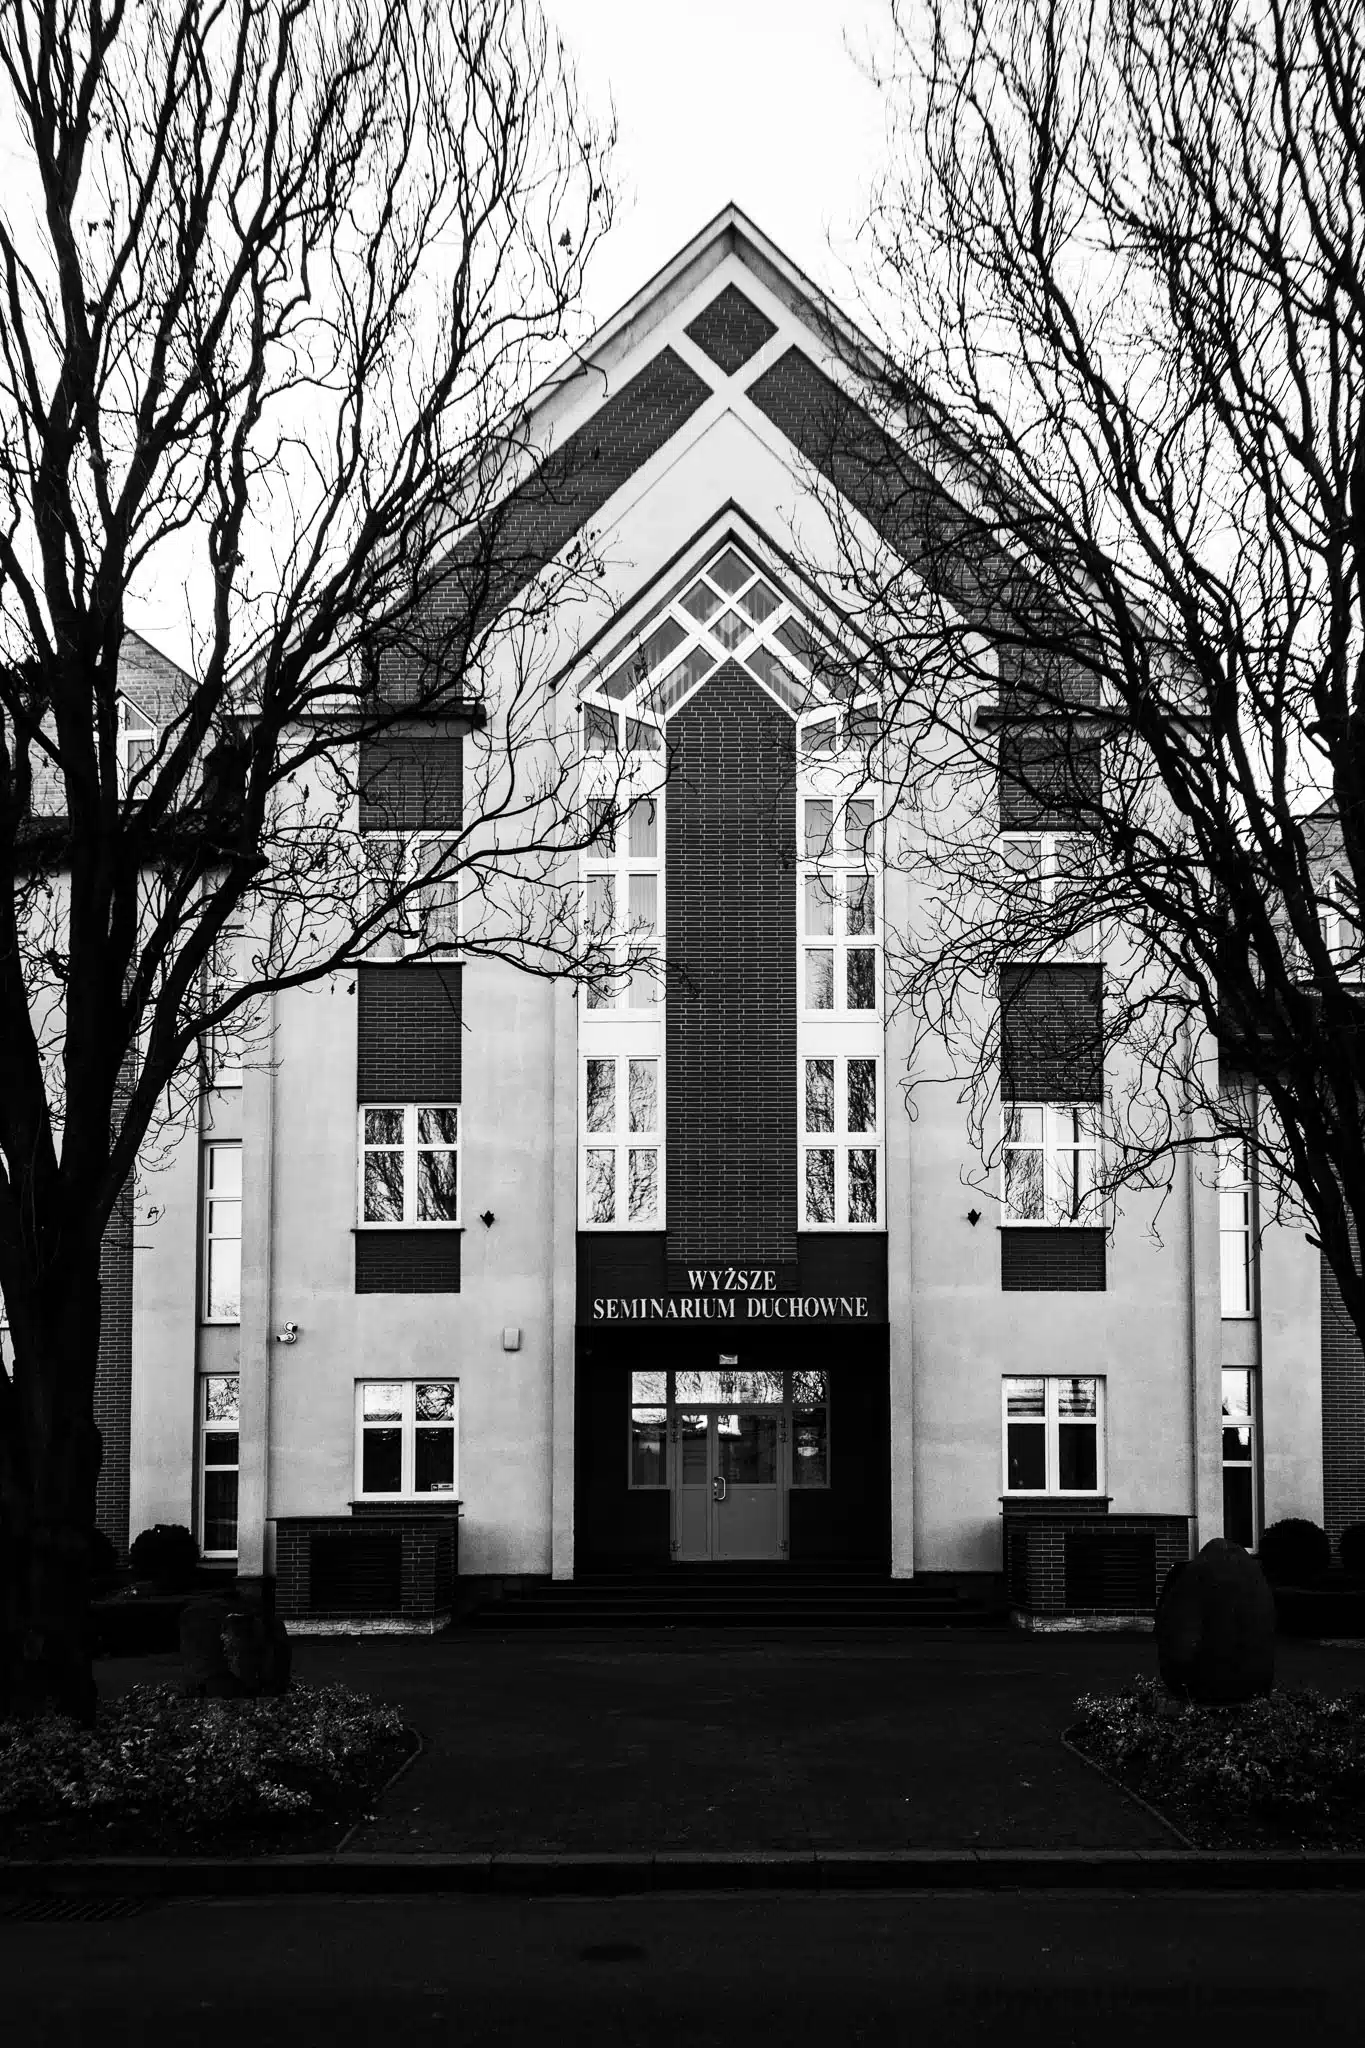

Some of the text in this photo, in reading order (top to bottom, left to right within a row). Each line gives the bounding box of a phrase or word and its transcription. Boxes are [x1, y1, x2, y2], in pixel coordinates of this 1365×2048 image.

[686, 1267, 777, 1291] WYŻSZE
[593, 1297, 868, 1319] SEMINARIUM DUCHOWNE
